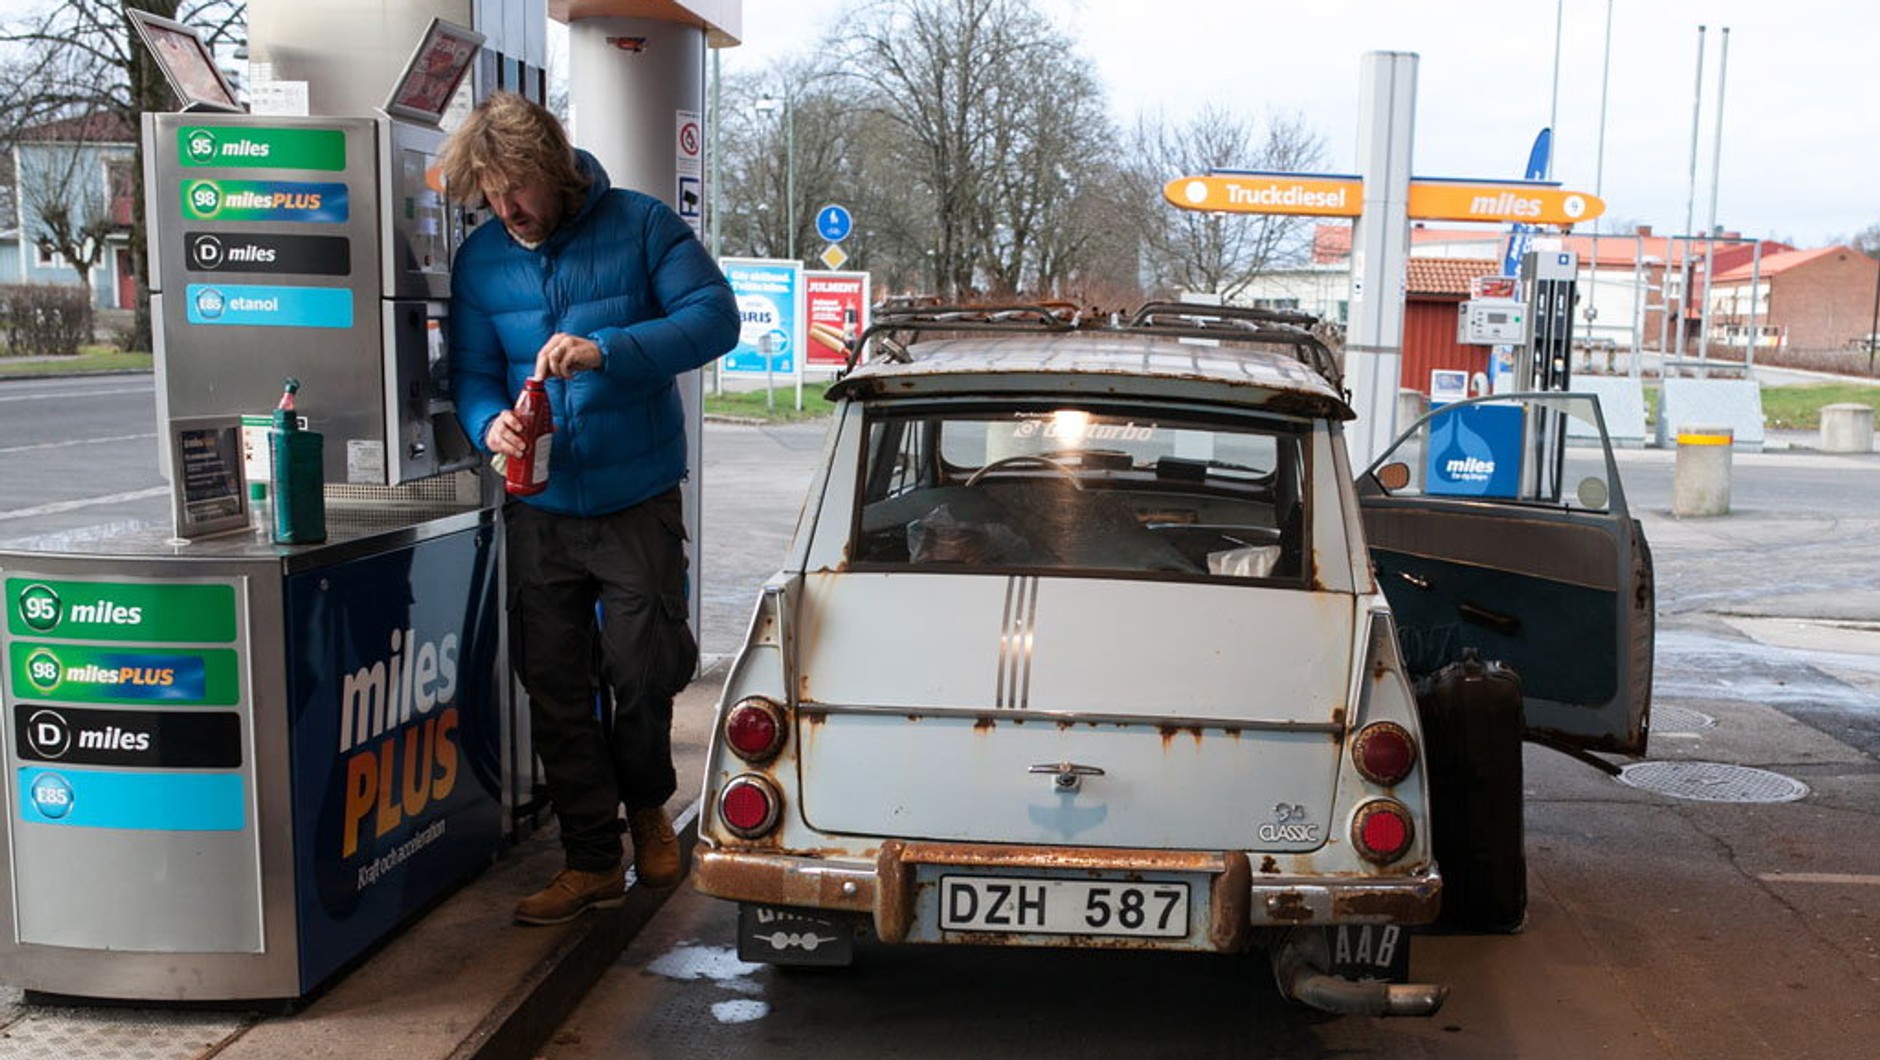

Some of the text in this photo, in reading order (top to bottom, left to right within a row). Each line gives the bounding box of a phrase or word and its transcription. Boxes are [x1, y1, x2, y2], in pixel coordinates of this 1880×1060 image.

[191, 138, 269, 157] 95 miles
[194, 190, 321, 209] 98 milesPLUS
[1226, 184, 1345, 208] Truckdiesel
[1470, 192, 1542, 217] miles
[200, 244, 276, 262] D miles
[229, 297, 279, 312] etanol
[1446, 456, 1496, 473] miles
[26, 597, 142, 624] 95 miles
[32, 662, 174, 686] 98 milesPLUS
[340, 628, 457, 753] miles
[38, 723, 150, 751] D miles
[343, 708, 459, 859] PLUS
[36, 787, 68, 805] E85
[949, 883, 1182, 930] DZH 587
